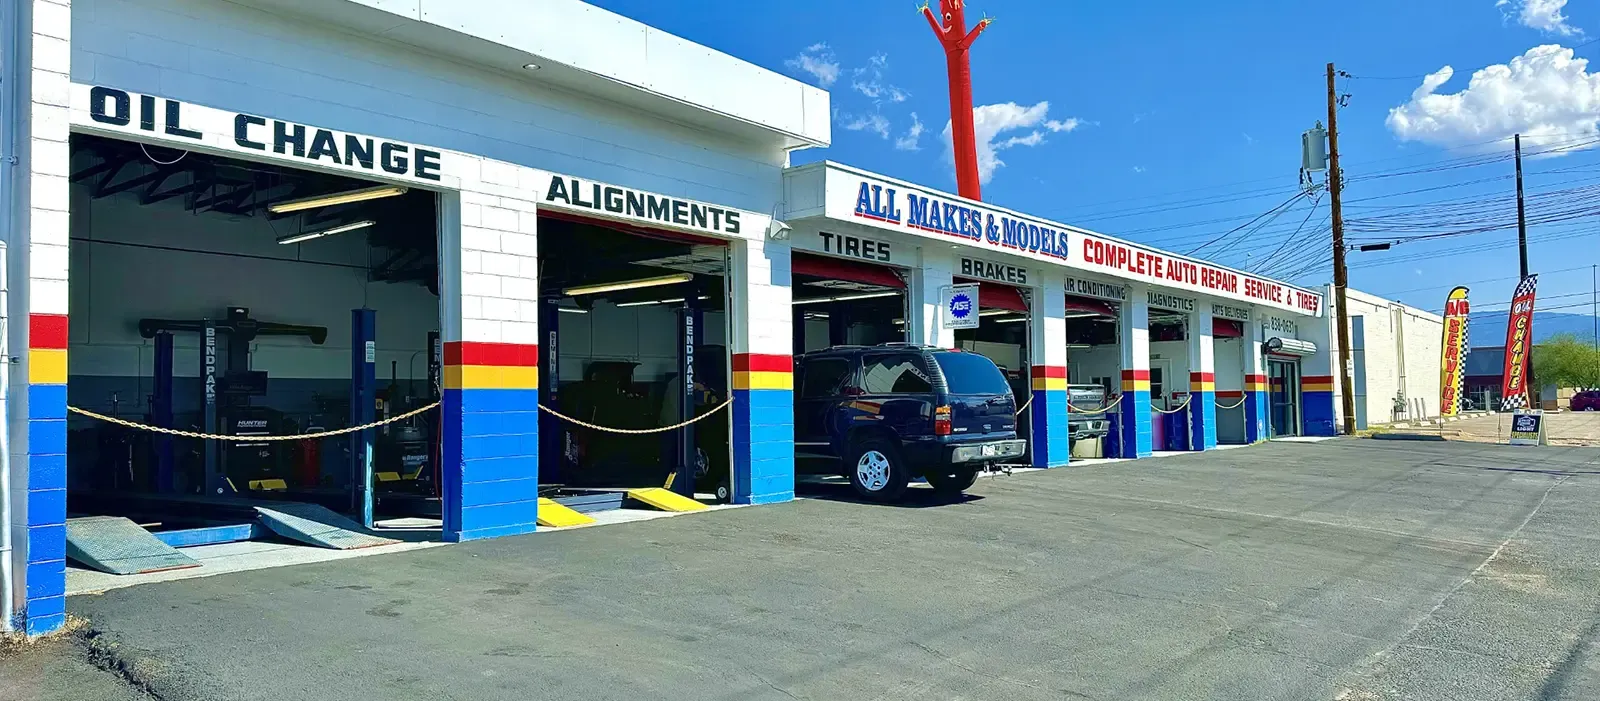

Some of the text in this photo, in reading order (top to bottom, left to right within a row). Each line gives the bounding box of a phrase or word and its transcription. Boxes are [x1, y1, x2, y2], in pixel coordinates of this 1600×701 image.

[90, 85, 441, 181] OIL CHANGE
[546, 175, 741, 234] ALIGNMENTS
[854, 181, 1069, 259] ALL MAKES & MODELS
[819, 231, 891, 262] TIRES
[961, 258, 1027, 284] BRAKES
[1083, 239, 1318, 313] COMPLETE AUTO REPAIR SERVICE & TIRES
[952, 301, 969, 311] ASE
[1077, 279, 1126, 300] CONDITIONING
[1514, 300, 1531, 314] OIL
[206, 327, 216, 393] BENDPAK
[686, 316, 694, 384] BENDPAK
[1442, 318, 1459, 414] SERVICE
[1509, 316, 1526, 389] CHANGE
